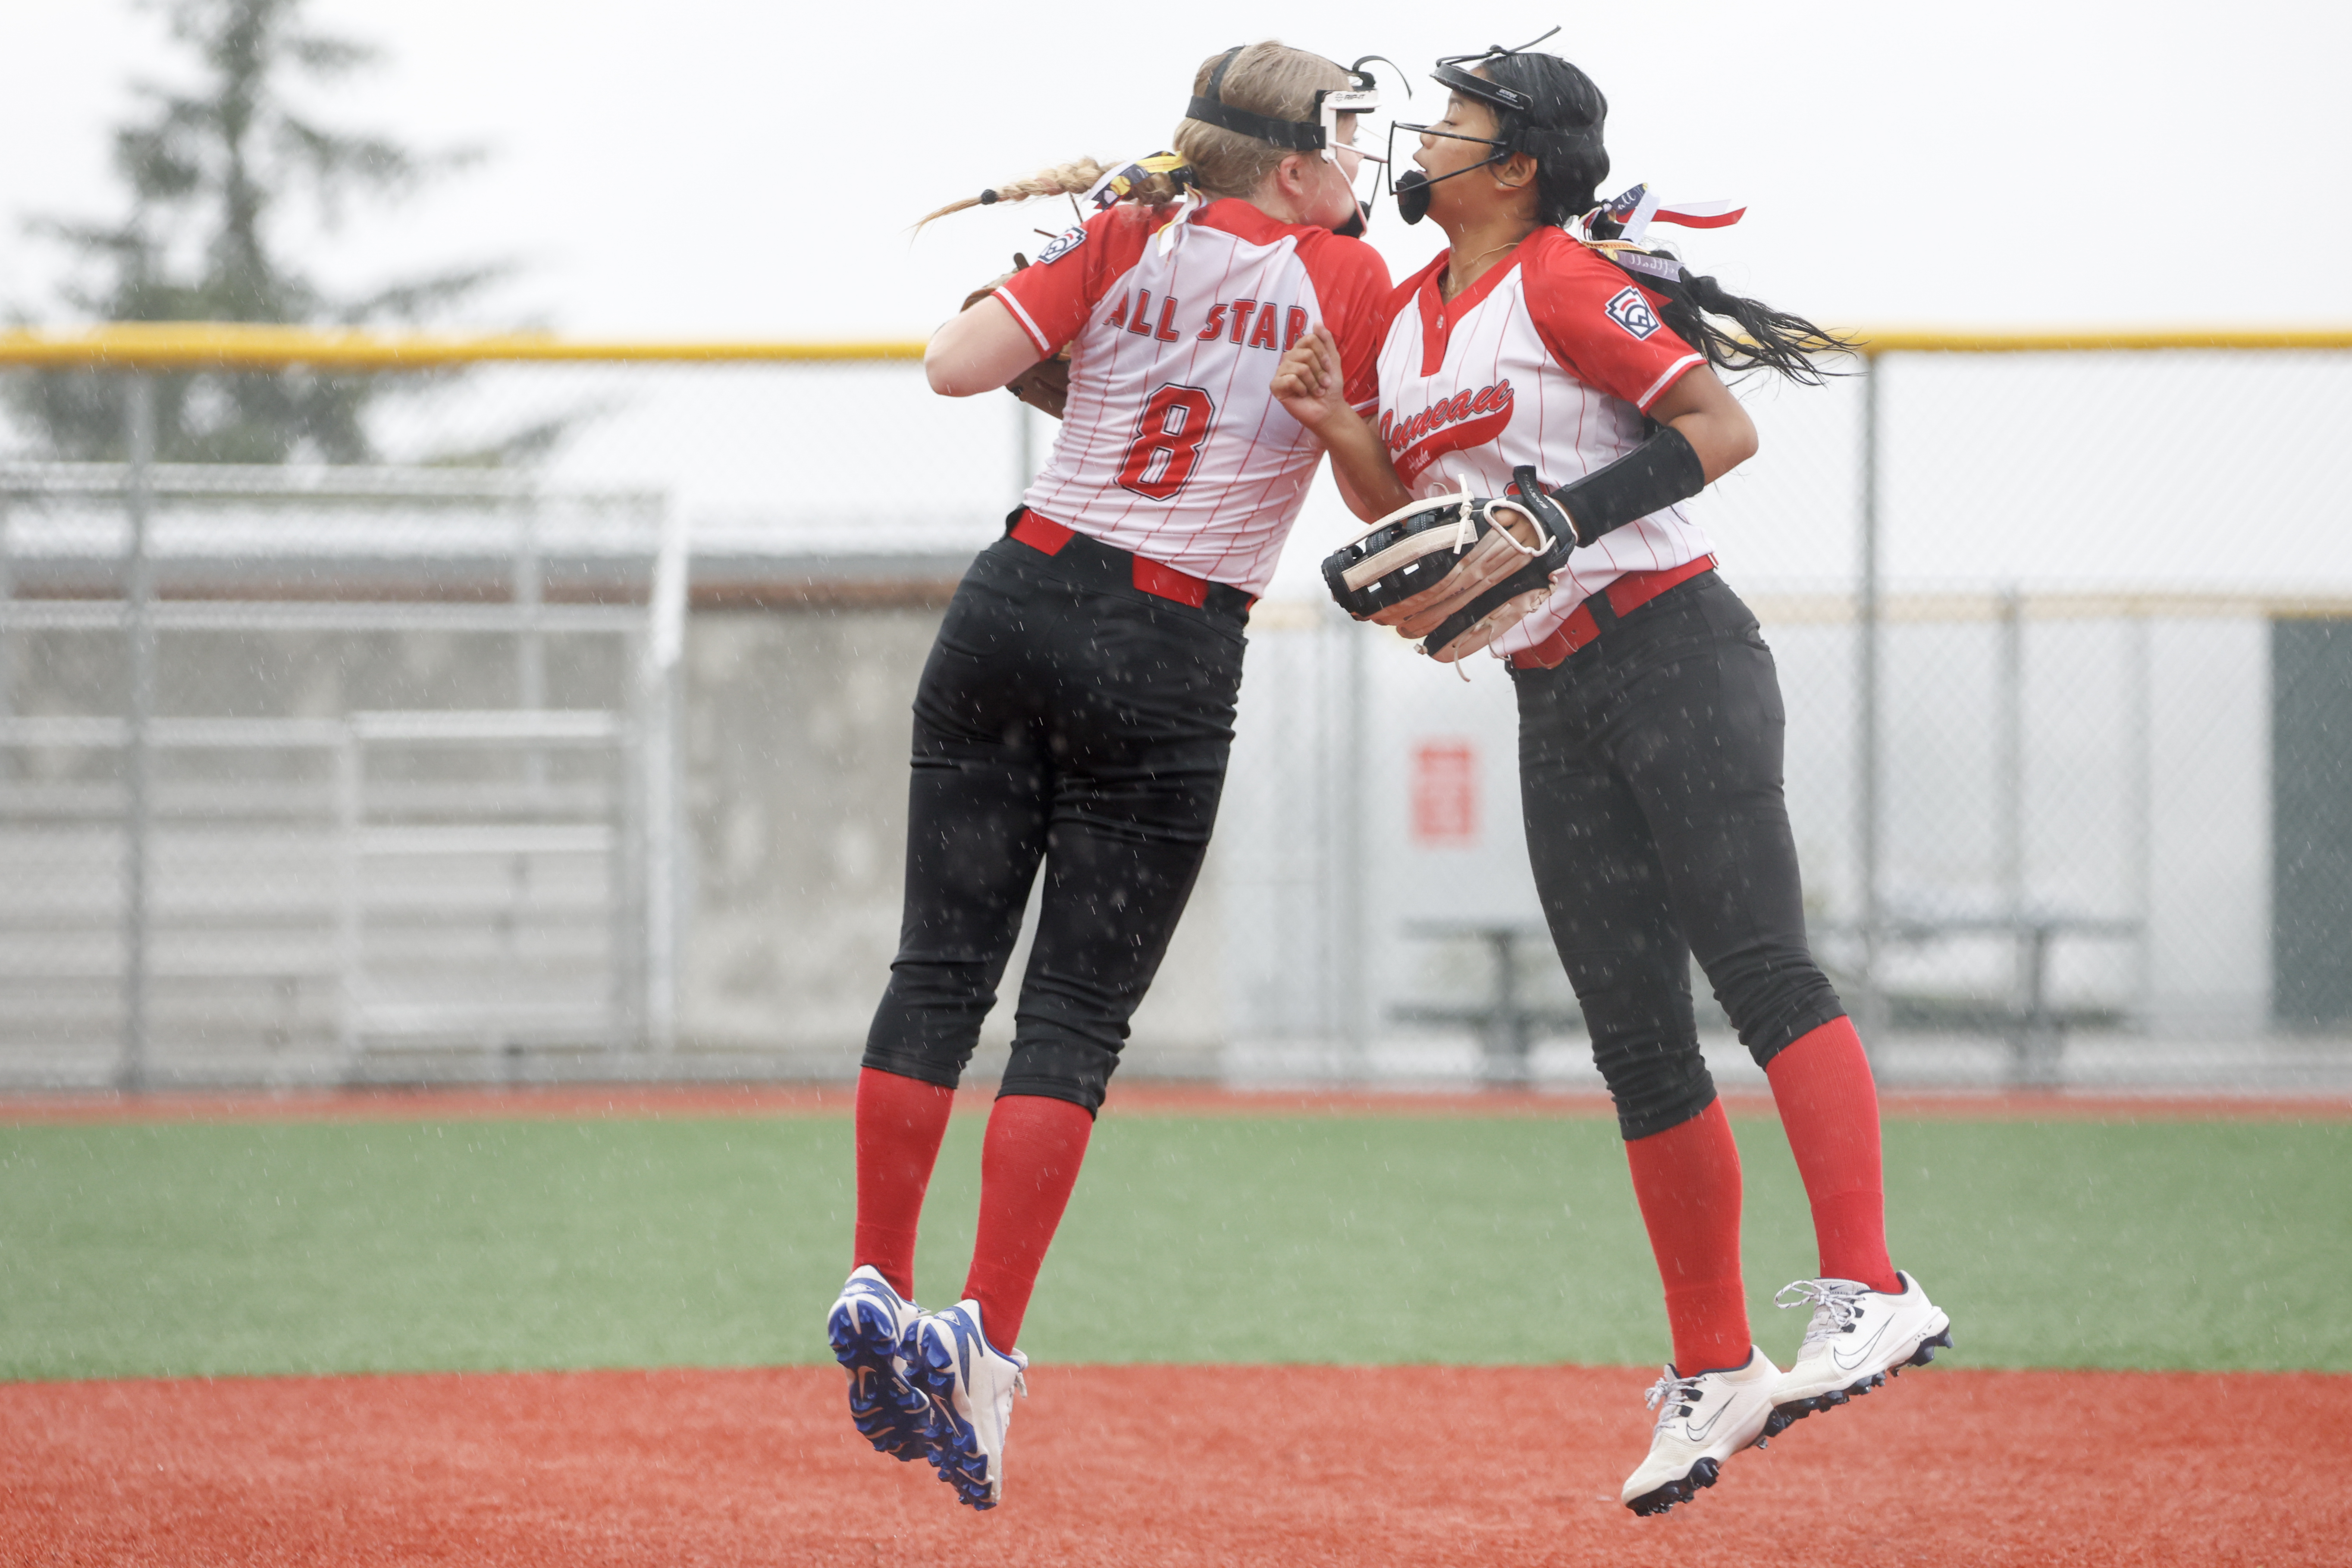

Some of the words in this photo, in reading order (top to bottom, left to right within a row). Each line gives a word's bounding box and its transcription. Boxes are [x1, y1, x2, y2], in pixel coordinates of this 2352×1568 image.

[1102, 287, 1180, 342] ALL
[1196, 298, 1308, 352] STAR
[1113, 382, 1215, 502] 8
[1380, 379, 1514, 452] Juneau
